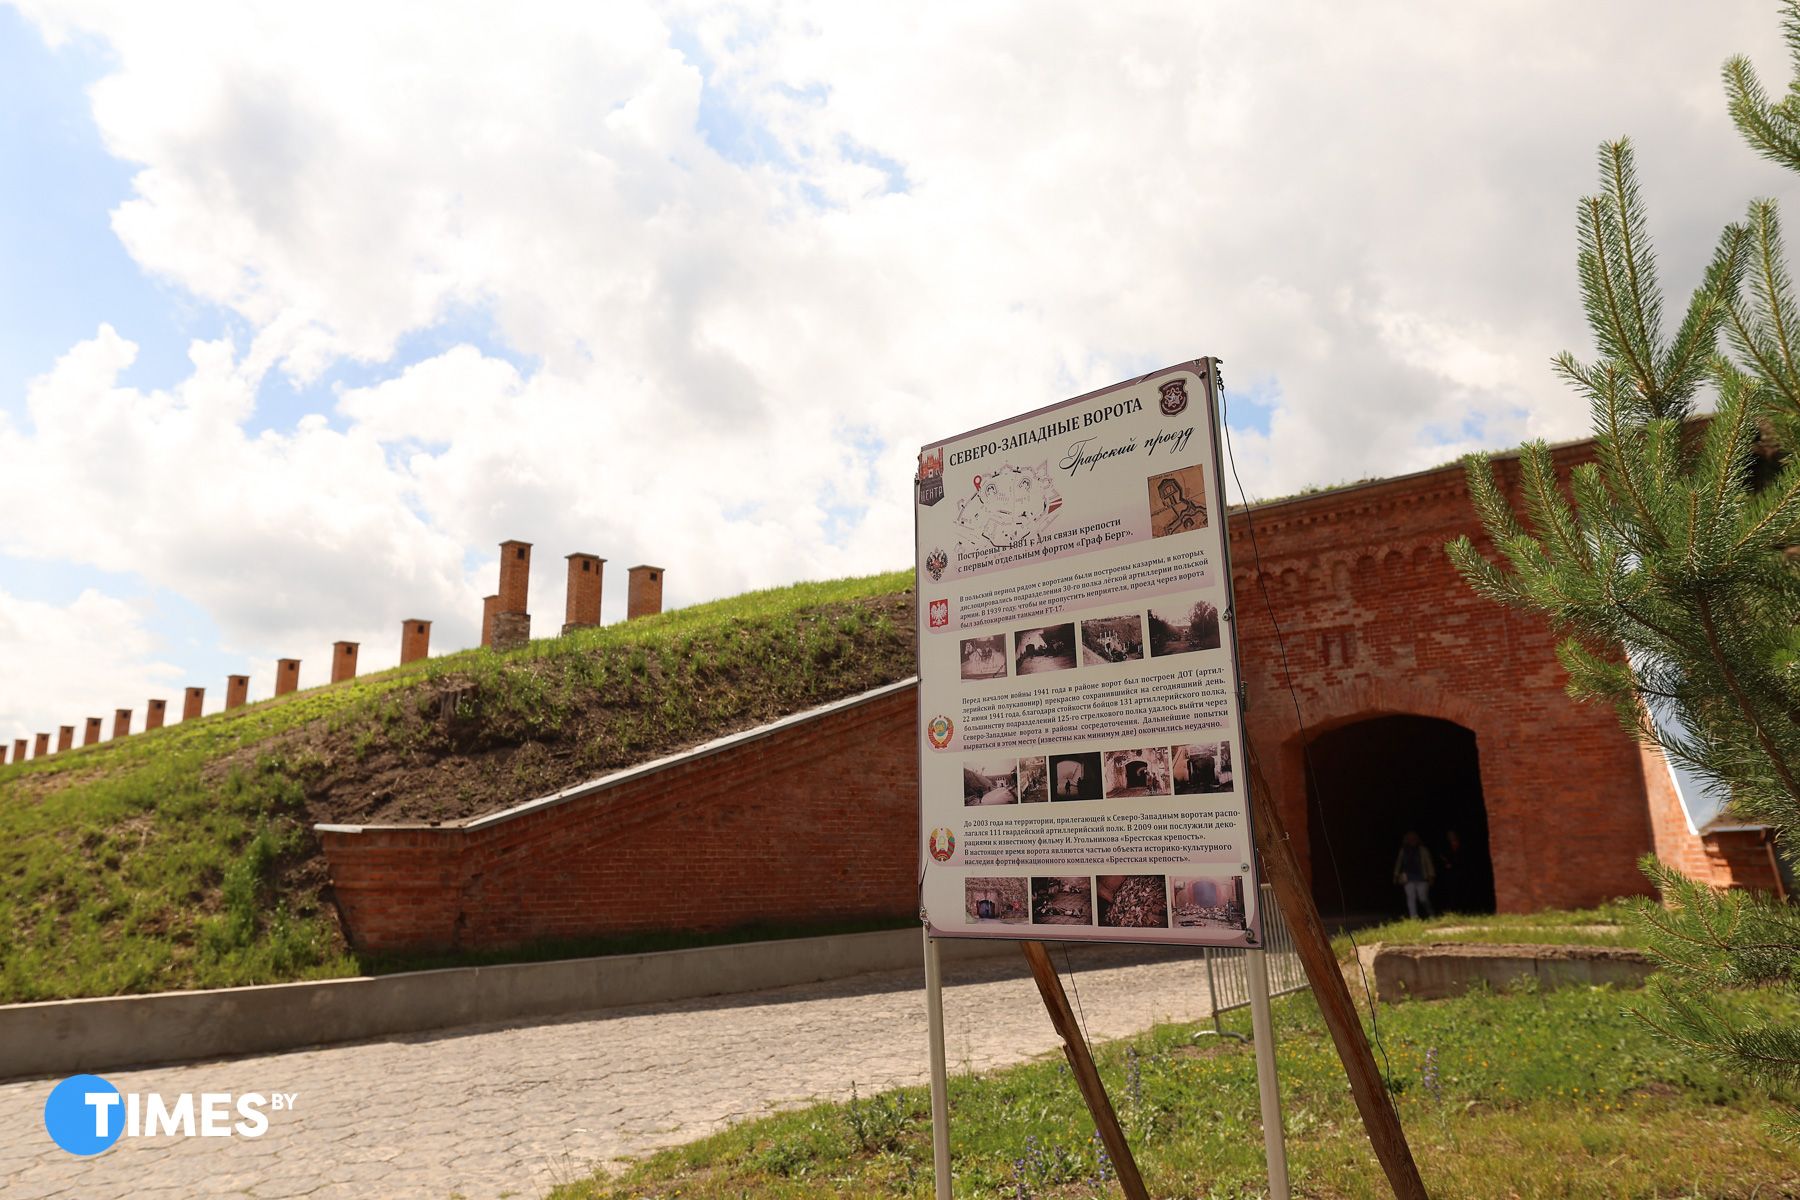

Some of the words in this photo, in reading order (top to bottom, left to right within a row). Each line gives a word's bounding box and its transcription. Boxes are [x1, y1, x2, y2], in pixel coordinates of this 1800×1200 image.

[949, 416, 1080, 466] СЕВЕРО-ЗАПАДНЫЕ
[1083, 398, 1143, 427] ВОРОТА
[1059, 436, 1138, 476] Графский
[1144, 426, 1194, 456] проезд
[958, 546, 1000, 561] Построены
[1009, 539, 1028, 550] 1881
[1054, 529, 1078, 540] связи
[1079, 520, 1121, 535] крепости
[963, 559, 994, 572] первым
[995, 548, 1040, 564] отдельным
[1042, 541, 1074, 556] фортом
[1076, 533, 1103, 547] «Граф
[960, 596, 1012, 612] дислоцировались
[1014, 587, 1061, 601] подразделения
[1063, 583, 1080, 592] 30-го
[1081, 579, 1102, 588] полка
[1103, 572, 1127, 584] лёгкой
[1129, 566, 1172, 580] артиллерии
[1173, 557, 1208, 571] польской
[965, 589, 993, 601] польский
[994, 587, 1015, 596] период
[1017, 583, 1036, 593] рядом
[1042, 576, 1073, 587] воротами
[1075, 572, 1092, 580] были
[1094, 564, 1131, 576] построены
[1172, 550, 1204, 561] которых
[987, 606, 1001, 615] 1939
[1018, 600, 1038, 609] чтобы
[1047, 592, 1085, 605] пропустить
[1130, 579, 1155, 590] проезд
[1156, 575, 1177, 584] через
[1178, 570, 1204, 580] ворота
[974, 613, 1016, 626] заблокирован
[1017, 609, 1044, 618] танками
[962, 697, 980, 705] Перед
[982, 694, 1009, 702] началом
[1010, 690, 1032, 698] войны
[1034, 687, 1049, 696] 1941
[1074, 682, 1099, 692] районе
[1101, 680, 1121, 688] ворот
[1141, 674, 1175, 683] построен
[1177, 670, 1193, 679] ДОТ
[1195, 668, 1225, 678] (артил-
[962, 703, 996, 714] лерийский
[997, 698, 1042, 710] полукапонир)
[1045, 695, 1080, 706] прекрасно
[1082, 688, 1138, 700] сохранившийся
[1152, 679, 1202, 692] сегодняшний
[964, 722, 1005, 731] большинству
[1006, 715, 1056, 728] подразделений
[1080, 710, 1123, 720] стрелкового
[1148, 704, 1178, 714] удалось
[1180, 701, 1203, 709] выйти
[1205, 699, 1228, 708] через
[1022, 708, 1056, 716] благодаря
[1057, 704, 1091, 713] стойкости
[1092, 700, 1118, 709] бойцов
[1134, 692, 1200, 706] артиллерийского
[963, 731, 1016, 741] Северо-Западные
[1020, 728, 1042, 737] ворота
[1052, 724, 1078, 734] районы
[1143, 714, 1190, 725] Дальнейшие
[1194, 710, 1228, 719] попытки
[963, 742, 996, 751] вырваться
[1038, 735, 1072, 745] (известны
[1087, 731, 1120, 739] минимум
[1121, 727, 1137, 737] две)
[1138, 725, 1183, 734] окончились
[1002, 827, 1045, 837] гвардейский
[1046, 825, 1104, 835] артиллерийский
[1056, 815, 1105, 825] прилегающей
[1113, 814, 1179, 822] Северо-Западным
[1038, 837, 1064, 846] фильму
[1120, 835, 1162, 843] «Брестская
[1144, 845, 1232, 853] историко-культурного
[995, 857, 1066, 866] фортификационного
[1106, 856, 1147, 864] «Брестская
